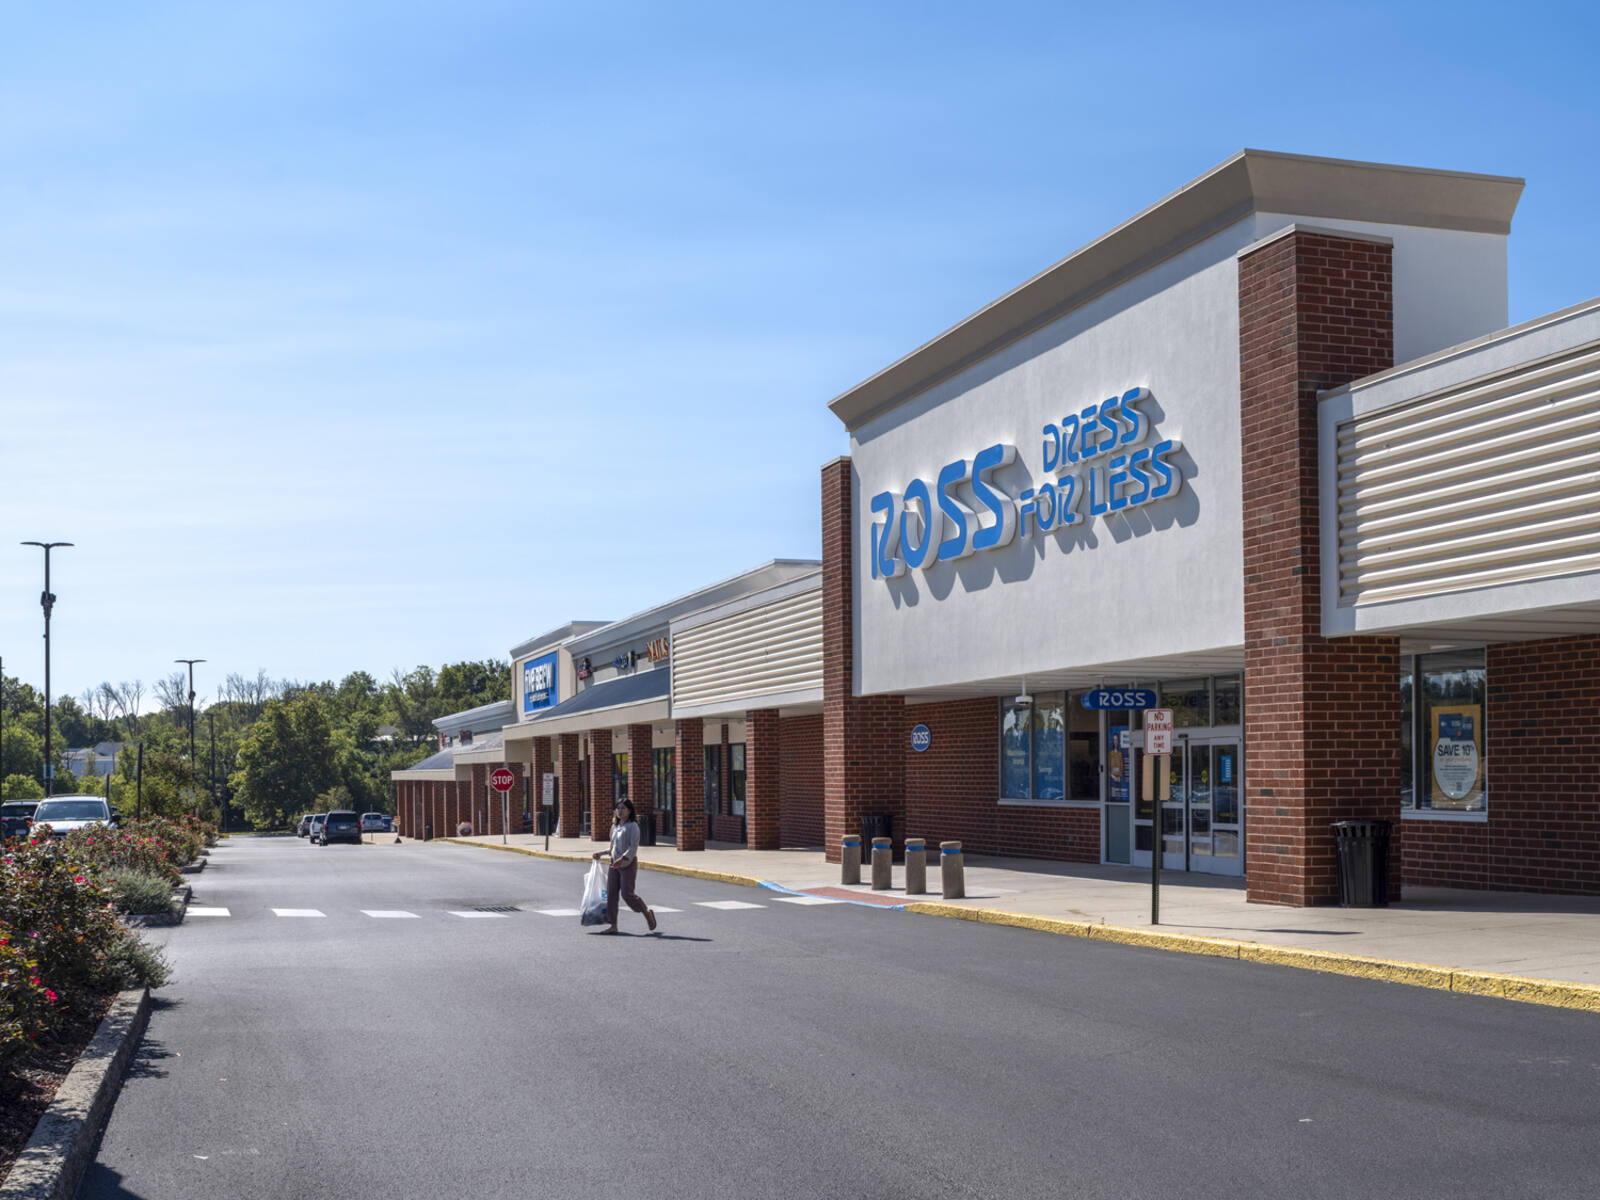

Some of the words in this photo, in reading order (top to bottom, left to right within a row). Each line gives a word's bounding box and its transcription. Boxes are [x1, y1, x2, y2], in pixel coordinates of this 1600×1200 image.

[1043, 387, 1141, 473] DRESS
[1020, 474, 1075, 539] FOR
[1090, 439, 1173, 516] LESS
[871, 443, 1004, 580] ROSS
[646, 637, 669, 662] NAILS
[1099, 692, 1146, 707] ROSS
[1154, 713, 1165, 721] NO
[1147, 723, 1172, 731] PARKING
[913, 732, 929, 744] ROSS
[1437, 744, 1460, 756] SAVE
[492, 775, 513, 785] STOP
